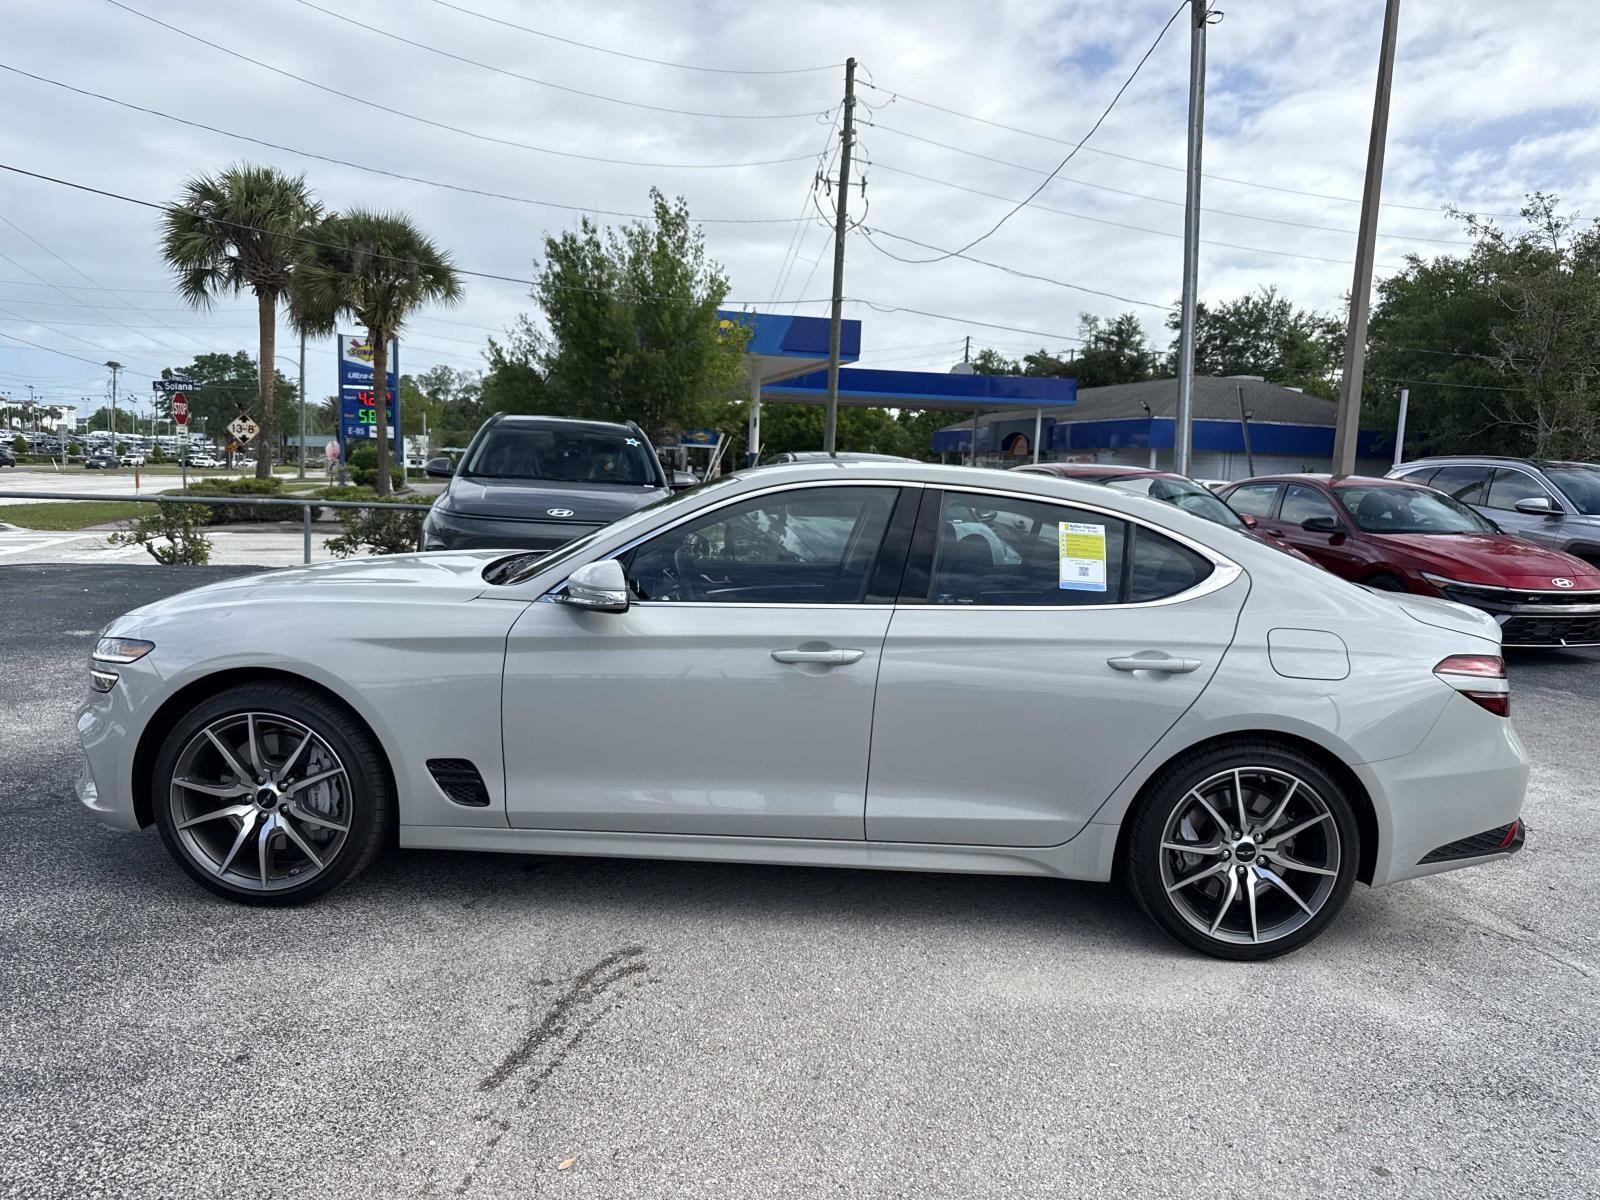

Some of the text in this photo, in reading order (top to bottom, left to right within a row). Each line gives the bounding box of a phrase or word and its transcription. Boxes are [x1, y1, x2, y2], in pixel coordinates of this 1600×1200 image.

[164, 382, 193, 391] Solana
[173, 402, 188, 415] STOP
[348, 426, 366, 436] E-85
